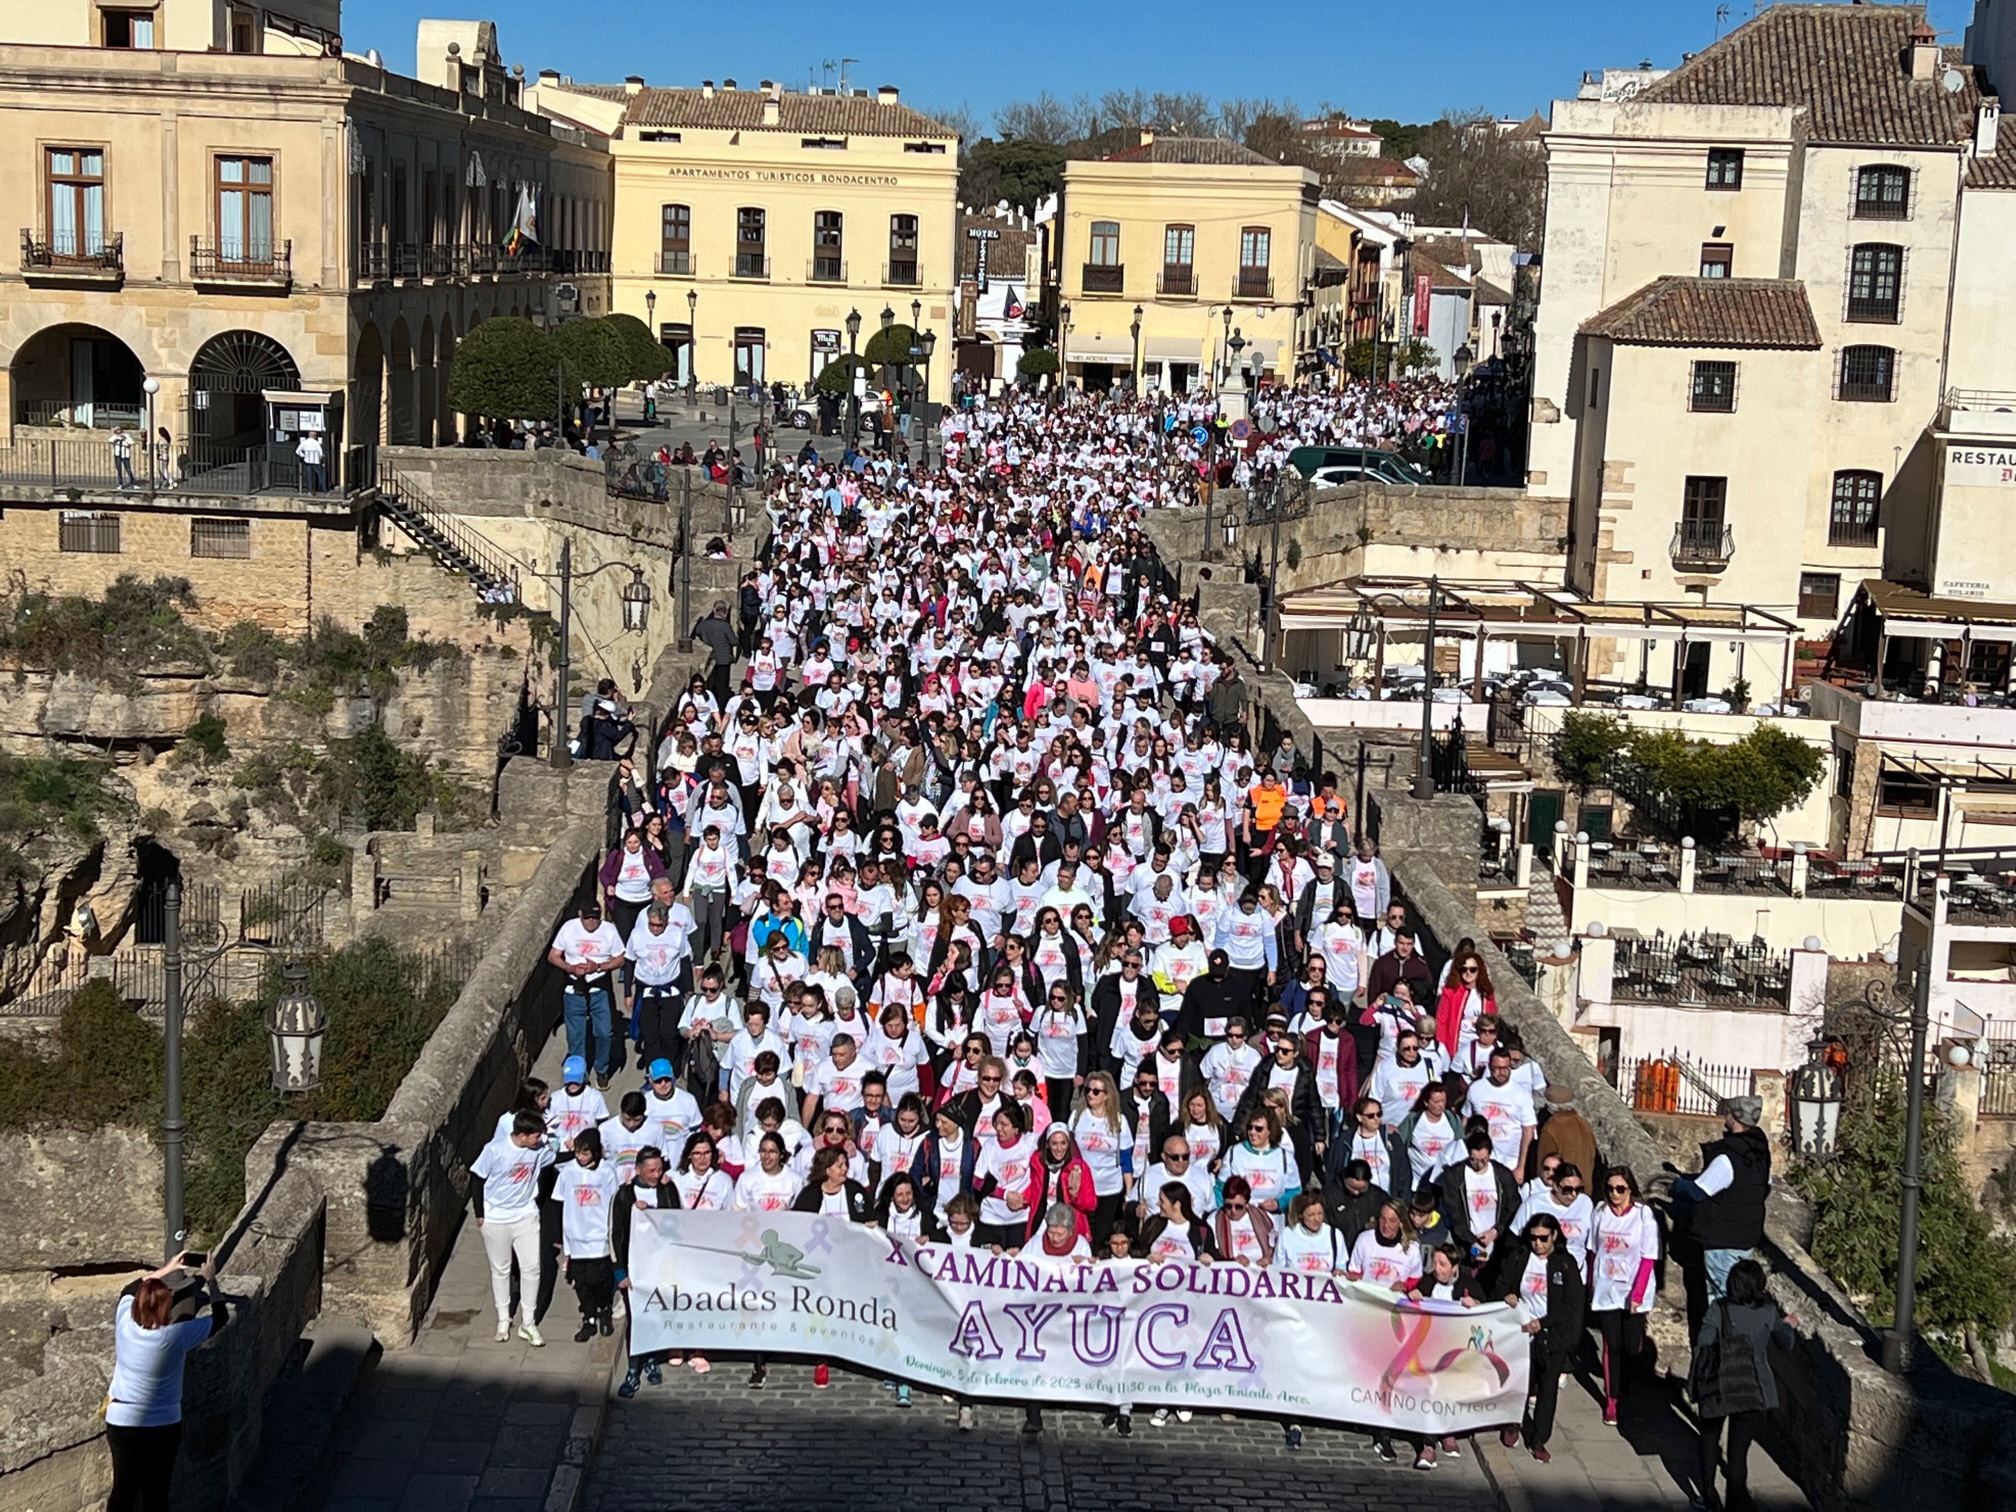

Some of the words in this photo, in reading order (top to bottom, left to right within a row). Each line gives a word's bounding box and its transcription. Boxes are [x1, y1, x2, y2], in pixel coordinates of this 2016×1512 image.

[669, 167, 750, 180] APARTAMENTOS
[756, 171, 815, 183] TURISTICOS
[821, 174, 898, 186] RONDACENTRO
[969, 228, 998, 239] HOTEL
[1943, 580, 1990, 590] CAFETERIA
[885, 1235, 908, 1267] X
[914, 1248, 1119, 1294] CAMINATA
[1132, 1263, 1344, 1304] SOLIDARIA
[643, 1281, 777, 1313] Abades
[791, 1284, 898, 1332] Ronda
[664, 1320, 777, 1331] Restaurante
[789, 1323, 797, 1332] &
[809, 1325, 876, 1346] eventos
[948, 1299, 1257, 1373] AYUCA
[984, 1372, 1028, 1387] febrero
[1147, 1383, 1162, 1393] en
[1165, 1380, 1179, 1393] la
[1184, 1381, 1221, 1399] Plaza
[1224, 1384, 1273, 1400] Teniente
[1350, 1386, 1416, 1412] CAMINO
[1420, 1399, 1498, 1416] CONTIGO
